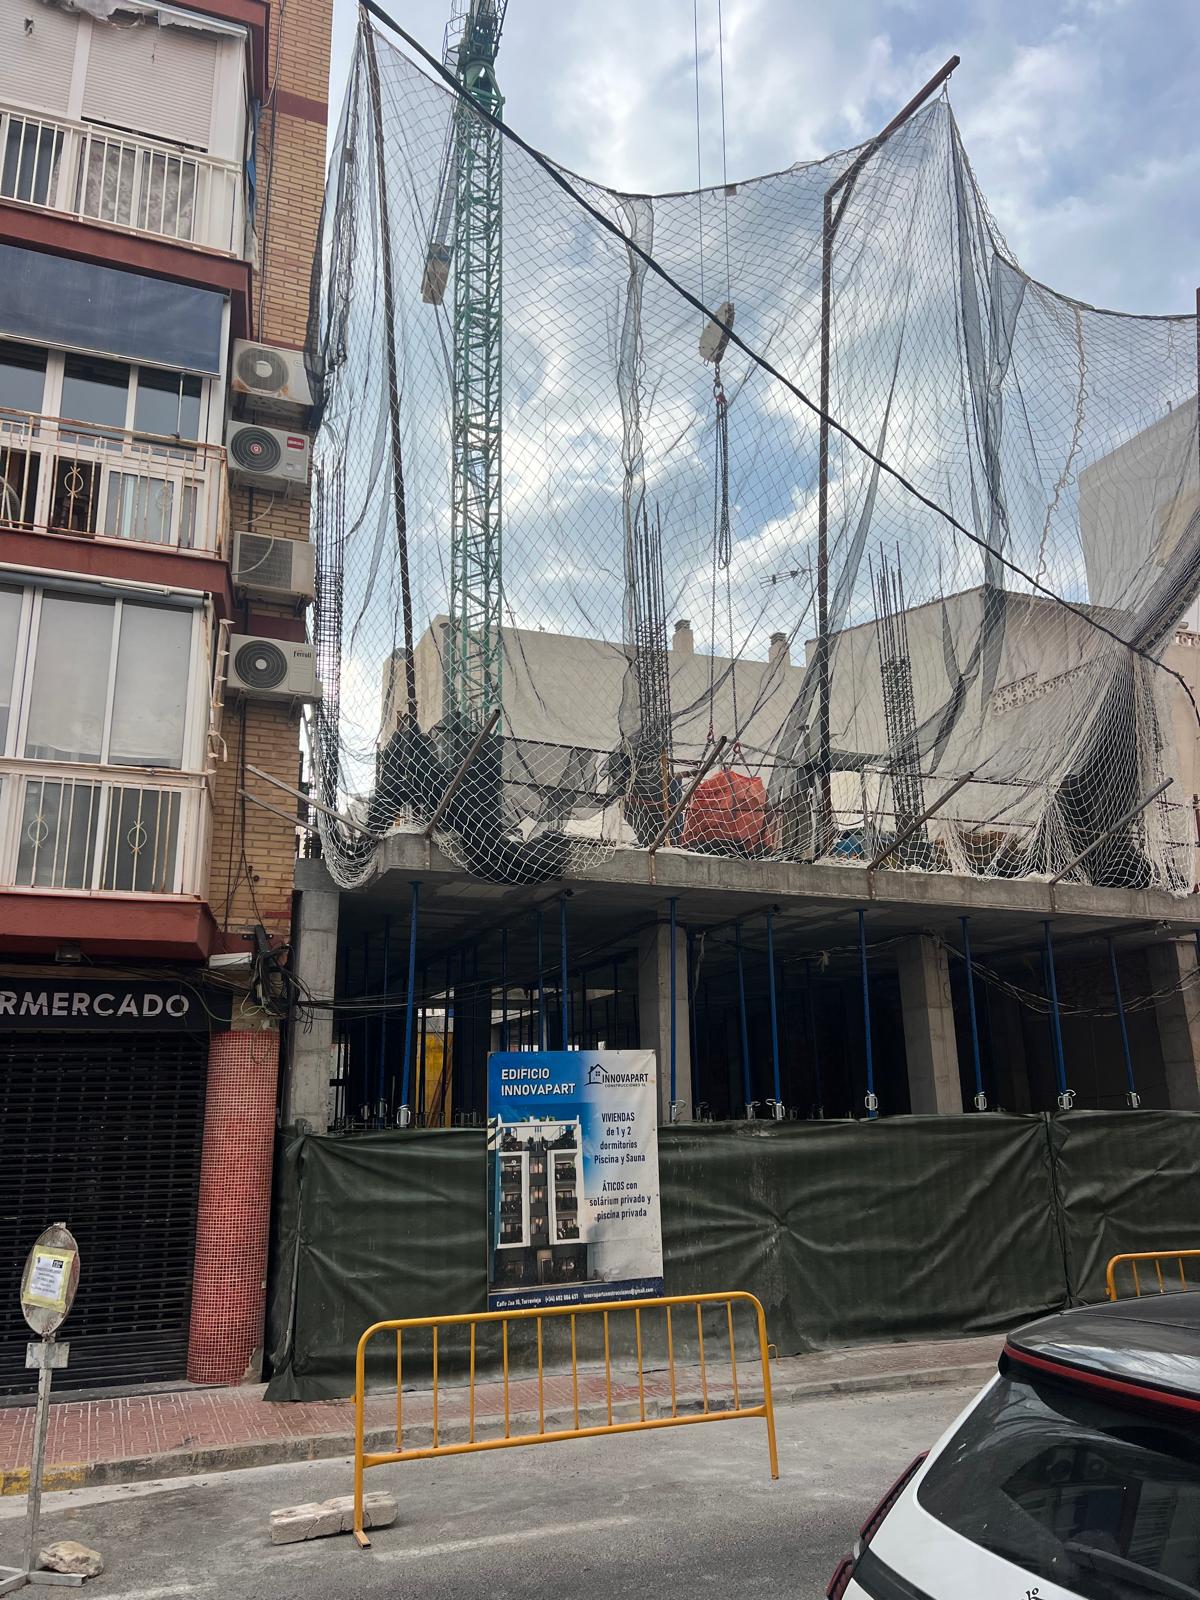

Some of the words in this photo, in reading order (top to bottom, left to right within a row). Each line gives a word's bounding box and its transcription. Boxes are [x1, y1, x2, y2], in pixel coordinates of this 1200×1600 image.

[0, 991, 190, 1017] RMERCADO
[501, 1067, 550, 1080] EDIFICIO
[602, 1073, 649, 1083] INNOVAPART
[501, 1083, 576, 1096] INNOVAPART
[601, 1112, 635, 1122] VIVIENDAS
[606, 1127, 615, 1136] de
[616, 1126, 620, 1136] 1
[621, 1129, 626, 1138] y
[627, 1126, 632, 1136] 2
[600, 1140, 638, 1150] dormitorios
[594, 1154, 619, 1164] Piscina
[620, 1156, 625, 1165] y
[625, 1153, 646, 1163] Sauna
[602, 1180, 625, 1192] ÁTICOS
[589, 1195, 619, 1207] solárium
[620, 1193, 646, 1206] privado
[647, 1195, 652, 1205] y
[597, 1209, 620, 1222] piscina
[621, 1207, 647, 1220] privada
